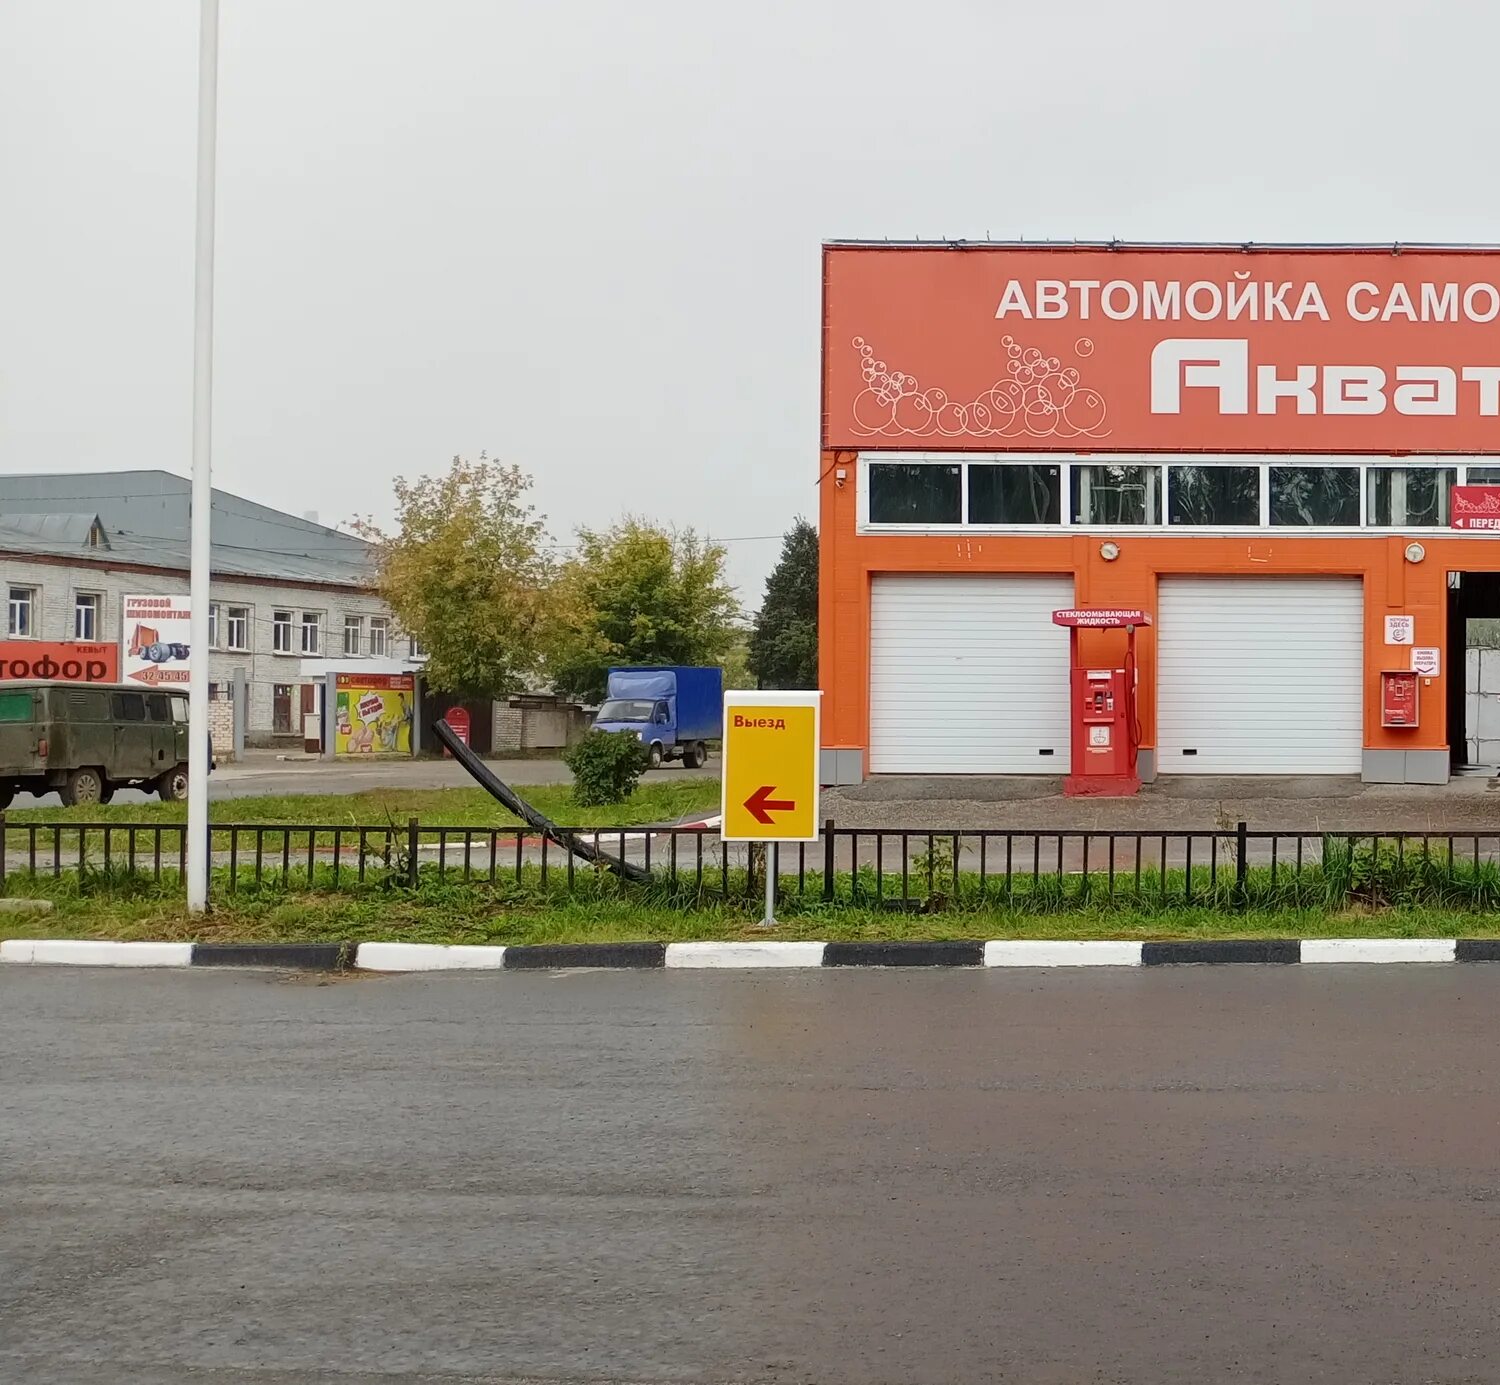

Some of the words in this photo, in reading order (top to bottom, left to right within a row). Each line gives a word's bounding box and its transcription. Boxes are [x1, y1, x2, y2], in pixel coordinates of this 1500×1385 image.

[995, 271, 1331, 321] АВТОМОЙКА
[1469, 518, 1500, 530] ПЕРЕД
[127, 597, 171, 608] ГРУЗОВОЙ
[1056, 610, 1141, 618] СТЕКЛООМЫВАЮЩАЯ
[1076, 617, 1121, 625] ЖИДКОСТЬ
[734, 714, 785, 730] Выезд
